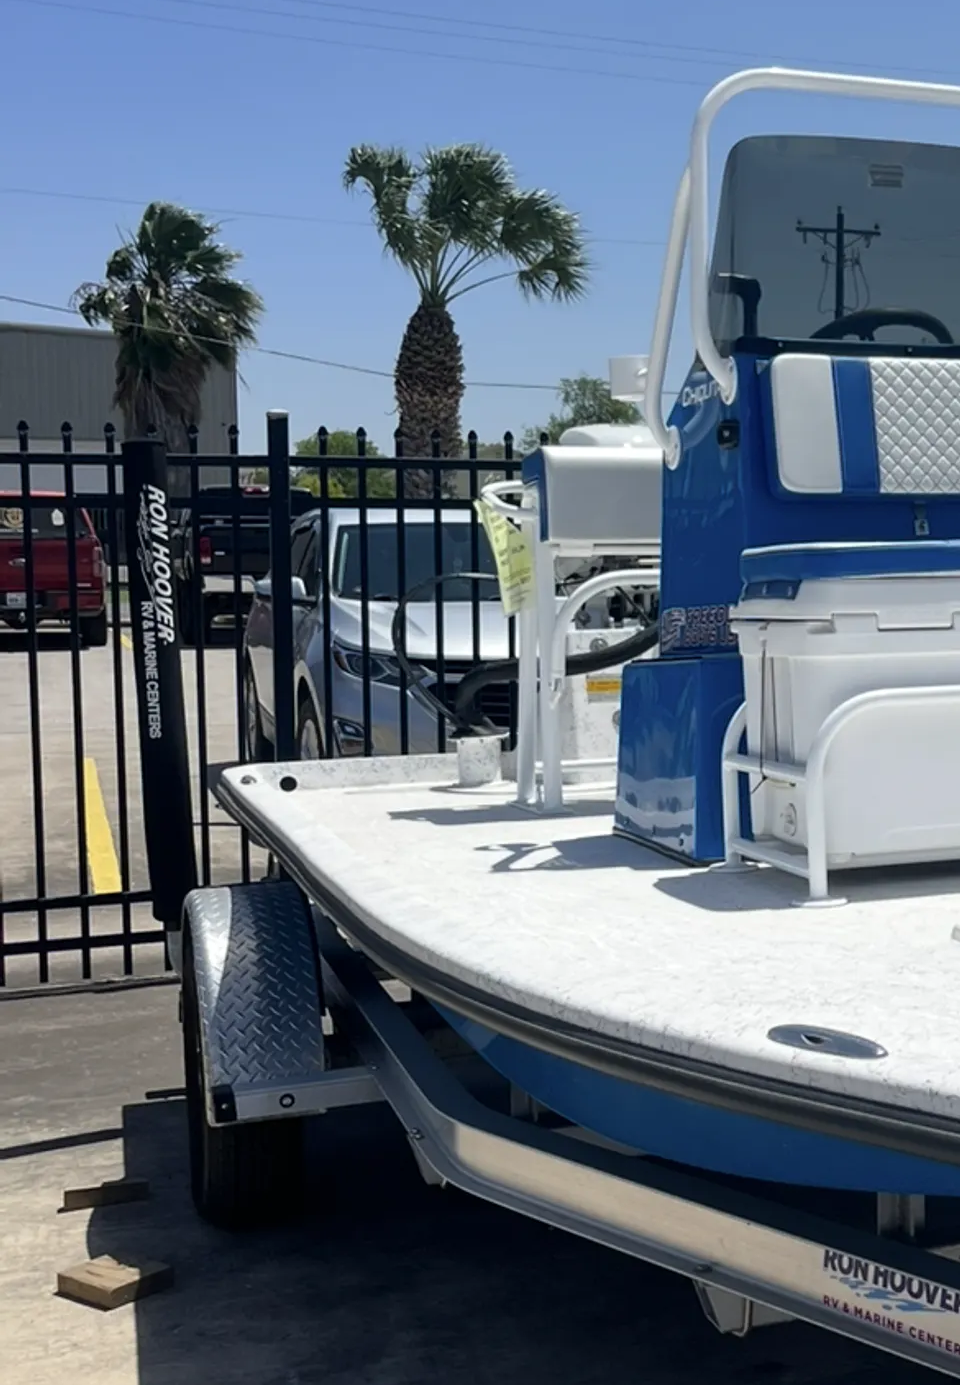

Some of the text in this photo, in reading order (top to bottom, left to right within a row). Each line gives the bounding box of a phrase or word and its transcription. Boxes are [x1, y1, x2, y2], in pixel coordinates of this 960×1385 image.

[148, 484, 176, 645] RON HOOVER
[141, 600, 162, 739] RV & MARINE CENTERS
[824, 1249, 868, 1282] RON
[823, 1295, 839, 1309] RV
[843, 1302, 849, 1313] &
[854, 1306, 903, 1334] MARINE
